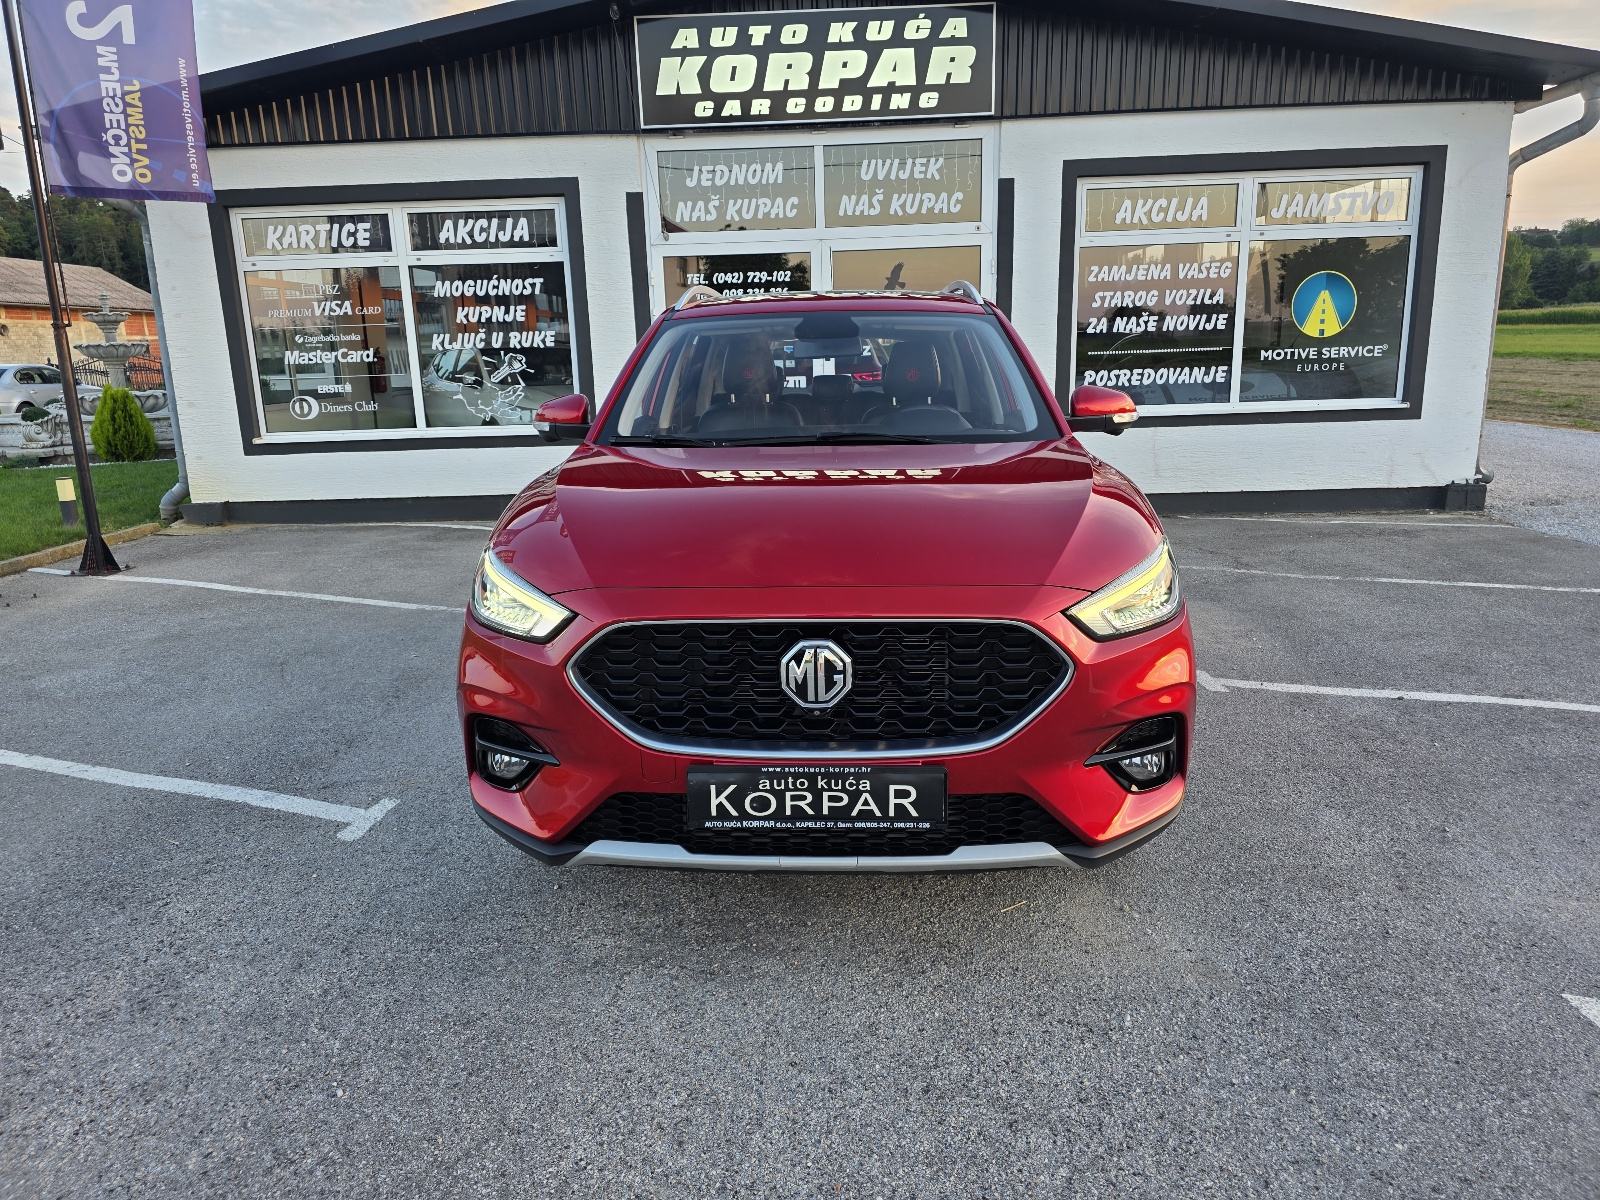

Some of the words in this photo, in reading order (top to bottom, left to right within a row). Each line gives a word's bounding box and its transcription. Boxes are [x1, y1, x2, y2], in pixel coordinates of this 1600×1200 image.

[670, 23, 809, 49] AUTO
[827, 13, 968, 43] KUĆA
[655, 45, 977, 96] KORPAR
[694, 98, 771, 117] CAR
[786, 91, 940, 114] CODING
[685, 162, 784, 188] JEDNOM
[860, 157, 944, 182] UVIJEK
[675, 194, 721, 224] NAŠ
[726, 196, 799, 222] KUPAC
[838, 189, 885, 217] NAŠ
[889, 192, 964, 216] KUPAC
[1114, 196, 1209, 225] AKCIJA
[1270, 190, 1395, 219] JAMSTVO
[266, 222, 372, 250] KARTICE
[439, 217, 530, 245] AKCIJA
[686, 273, 709, 285] TEL.
[712, 271, 744, 284] (042)
[747, 270, 791, 283] 729-102
[1087, 264, 1171, 283] ZAMJENA
[319, 284, 341, 295] PBZ
[433, 274, 544, 299] MOGUĆNOST
[268, 308, 312, 318] PREMIUM
[312, 300, 353, 316] VISA
[355, 306, 381, 315] CARD
[1091, 290, 1159, 308] STAROG
[1165, 288, 1225, 305] VOZILA
[455, 305, 526, 324] KUPNJE
[1086, 317, 1108, 334] ZA
[1113, 311, 1158, 333] NAŠE
[1162, 313, 1229, 331] NOVIJE
[340, 333, 361, 341] banka
[431, 329, 486, 351] KLJUČ
[491, 332, 502, 348] U
[508, 330, 556, 348] RUKE
[1260, 347, 1318, 362] MOTIVE
[1083, 365, 1229, 387] POSREDOVANJE
[1296, 362, 1346, 373] EUROPE
[317, 384, 344, 393] ERSTE
[321, 402, 353, 413] Diners
[354, 400, 379, 412] Club
[788, 648, 844, 702] MG
[761, 766, 871, 774] www.autokuca-korpar.hr
[758, 776, 809, 790] auto
[817, 775, 871, 791] kuća
[709, 784, 919, 817] KORPAR
[742, 820, 775, 828] KORPAR
